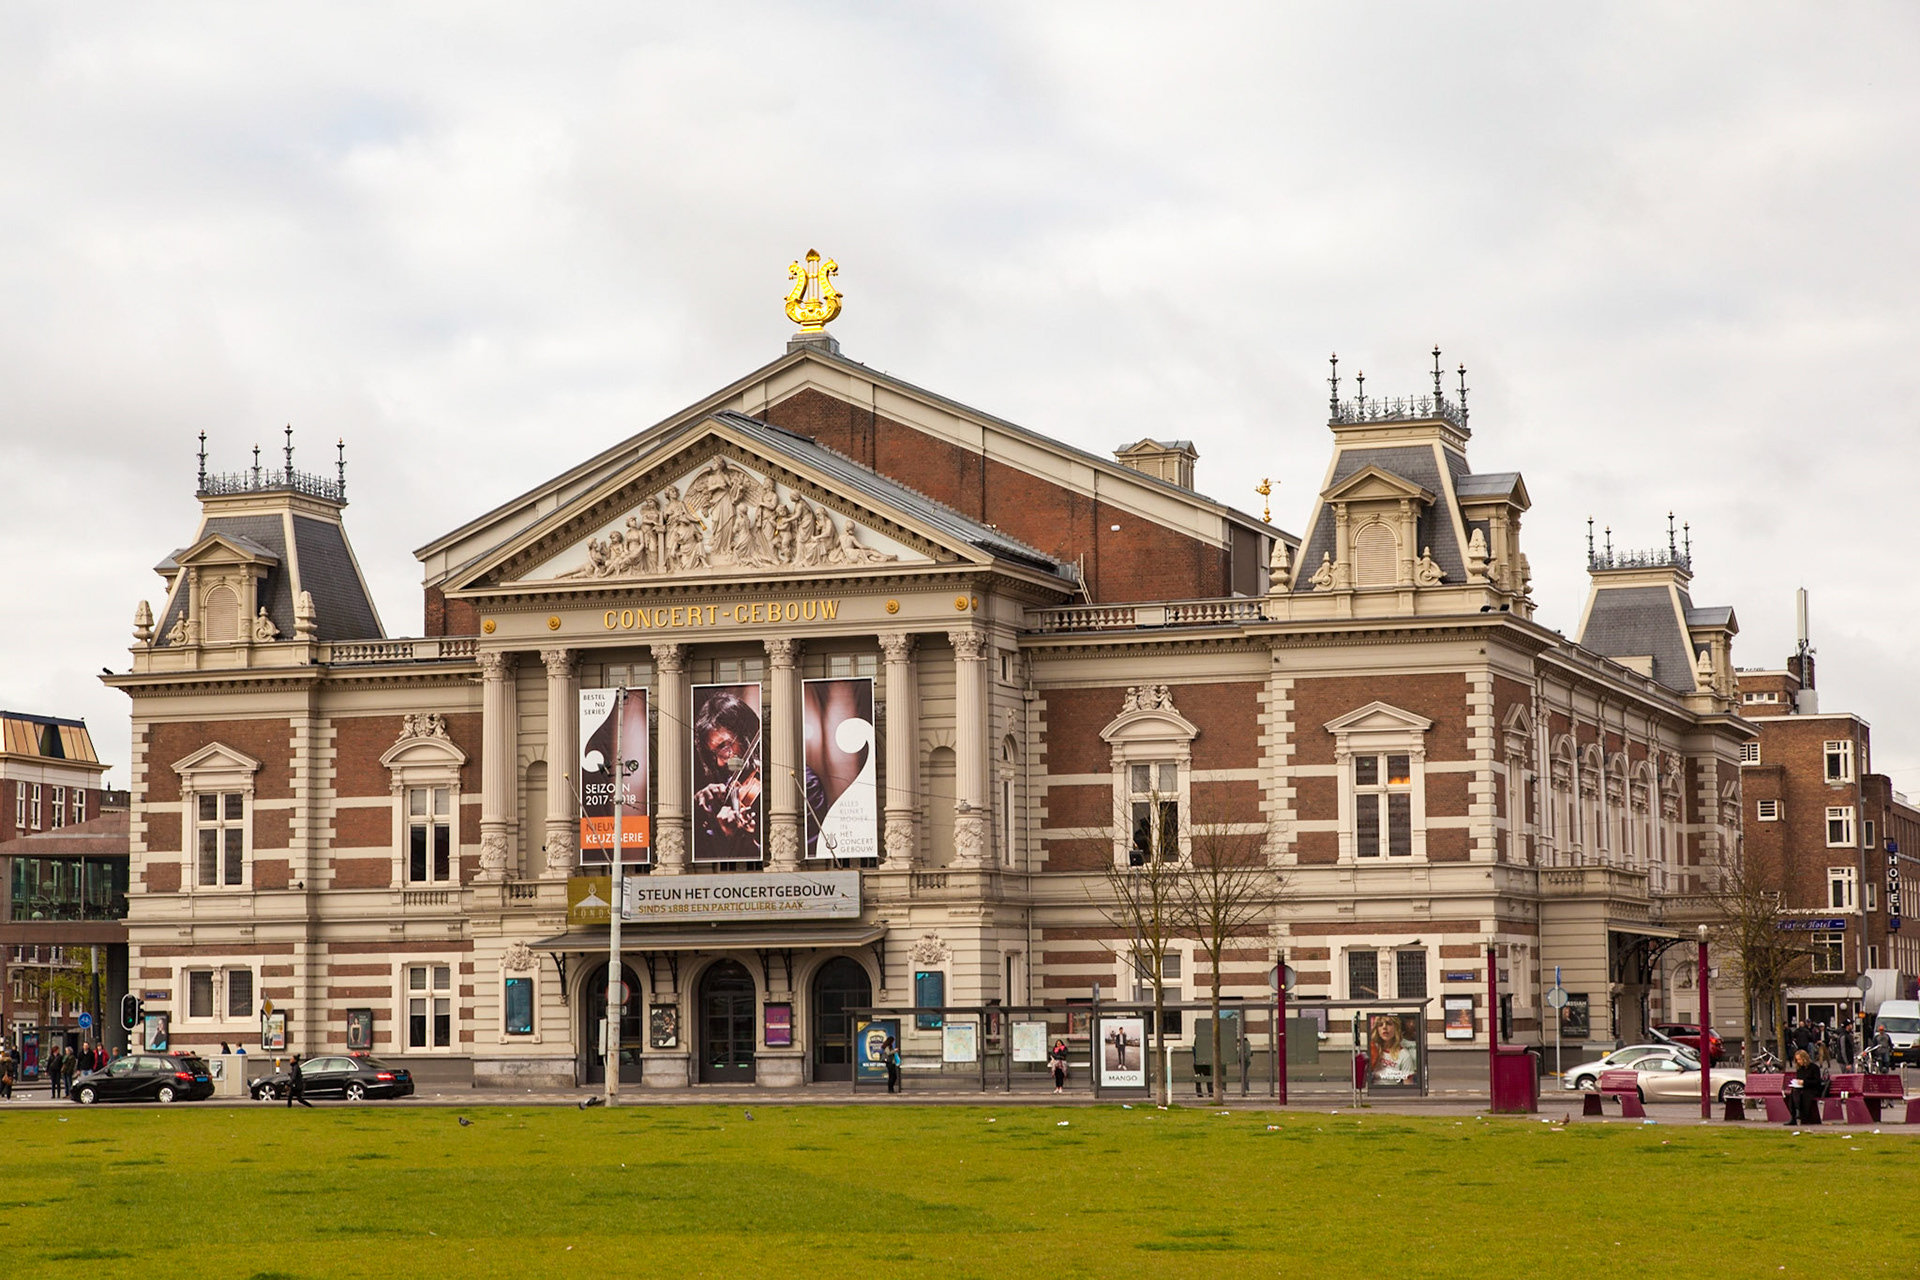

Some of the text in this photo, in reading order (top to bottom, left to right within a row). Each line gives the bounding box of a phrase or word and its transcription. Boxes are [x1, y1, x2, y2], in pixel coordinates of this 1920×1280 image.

[603, 599, 840, 630] CONCERT-GEBOUW
[585, 783, 631, 794] SEIZON
[585, 794, 637, 806] 2017-018
[585, 832, 644, 844] KEUZEERIE
[840, 845, 874, 853] GEBOUW
[1888, 855, 1900, 916] HOTEL
[638, 884, 836, 901] STEUN HET CONCERTGEBOUW
[638, 900, 804, 914] SINDS 1888 EEN PARTICULIERE ZAAK
[1808, 919, 1832, 930] Hotel
